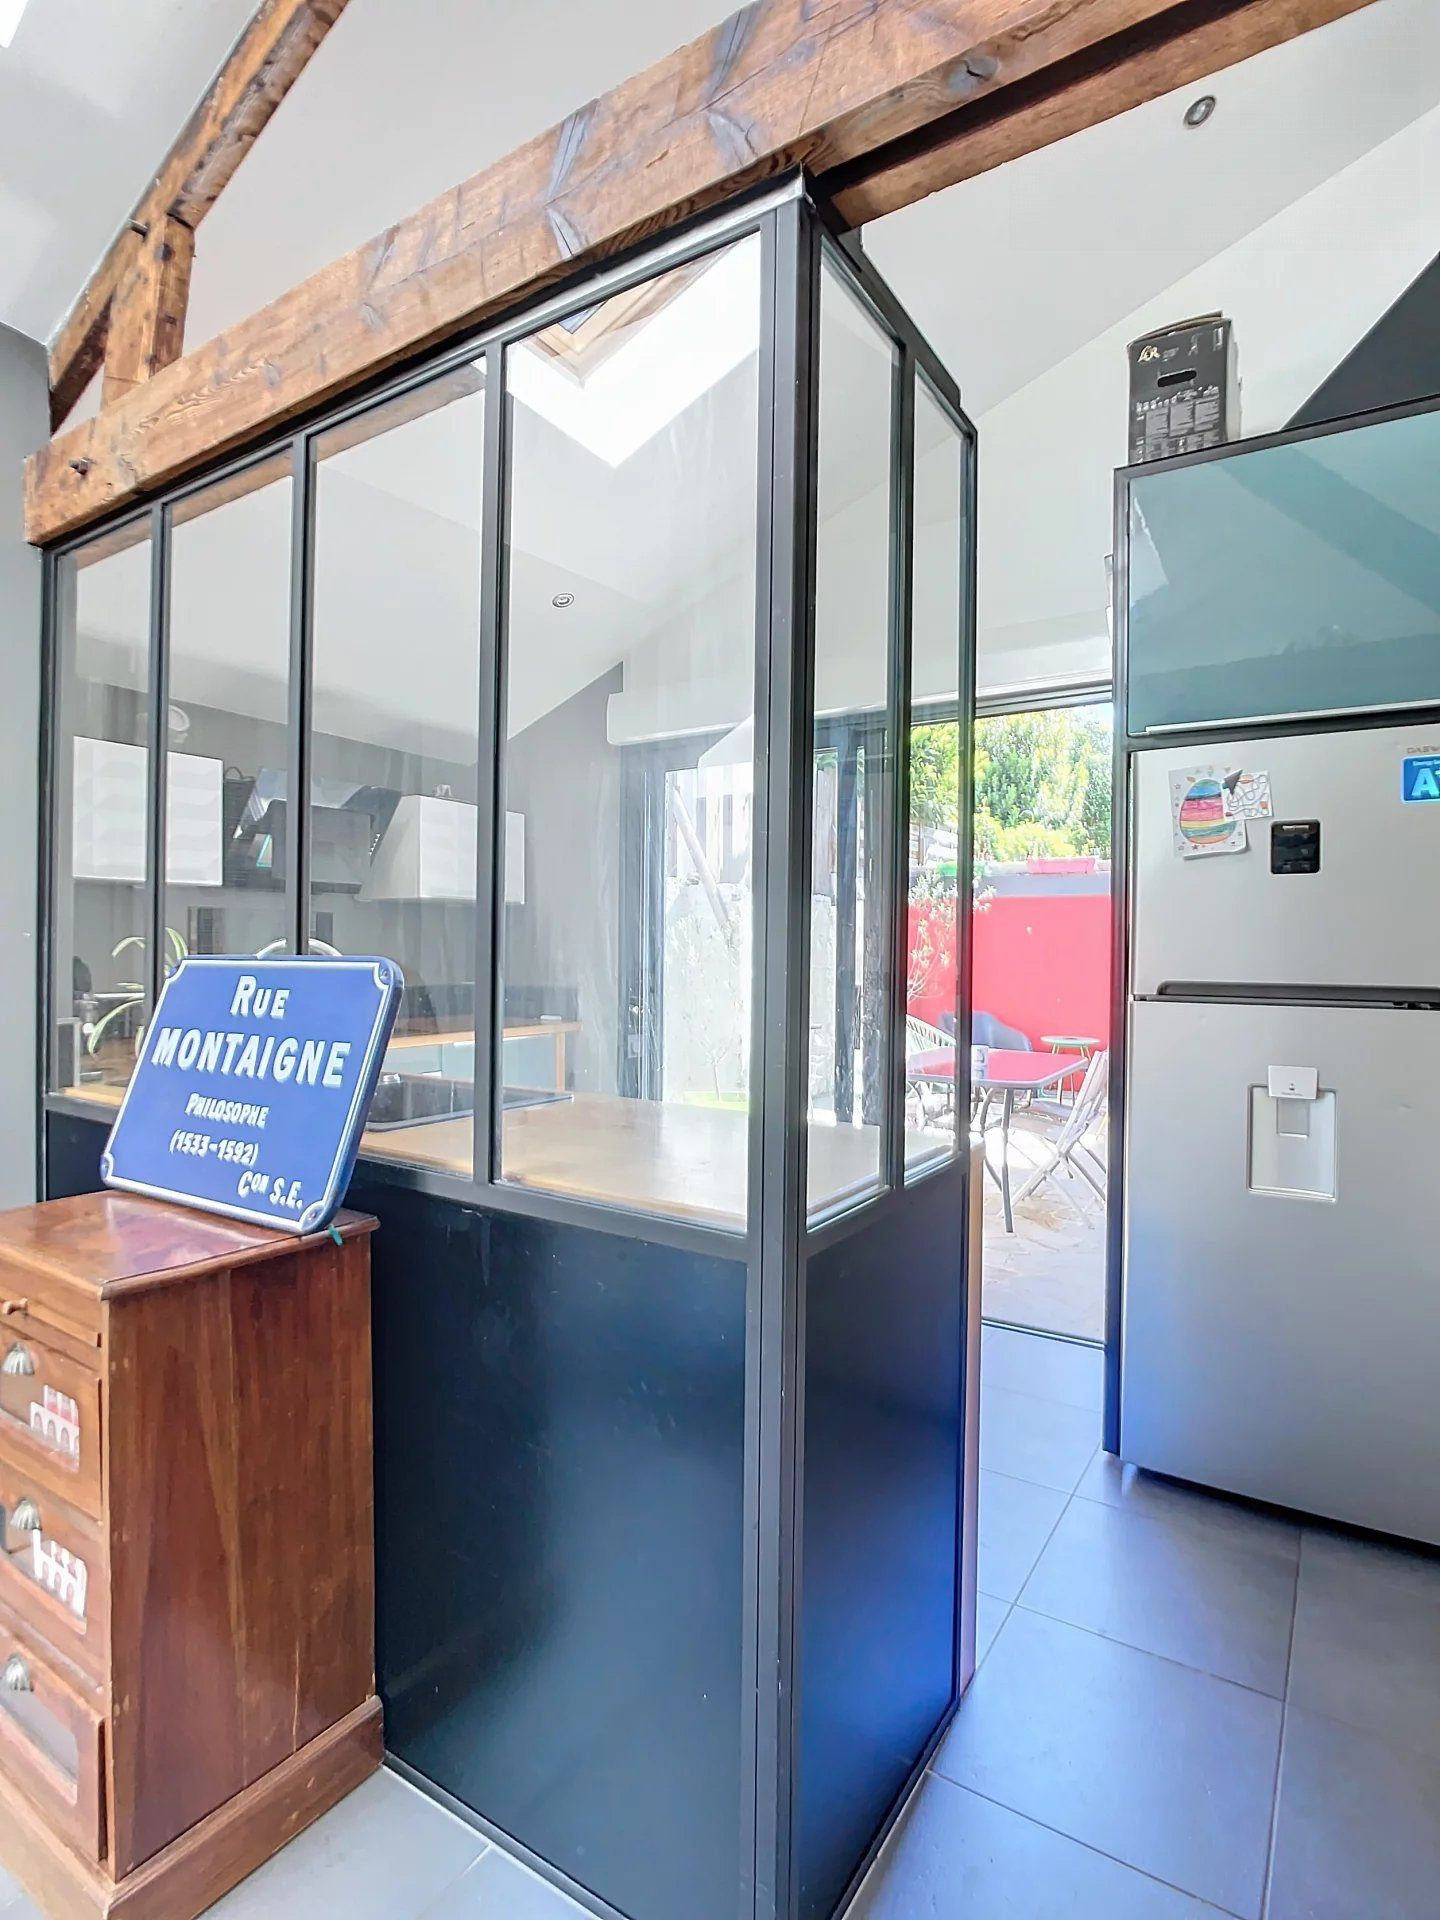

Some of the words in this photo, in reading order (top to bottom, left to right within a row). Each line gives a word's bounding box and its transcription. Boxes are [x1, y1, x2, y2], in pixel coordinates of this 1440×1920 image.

[230, 975, 290, 1019] RUE
[151, 1027, 351, 1088] MONTAIGNE
[184, 1092, 270, 1128] PHILOSOPHE
[169, 1129, 259, 1167] (1533-1592)
